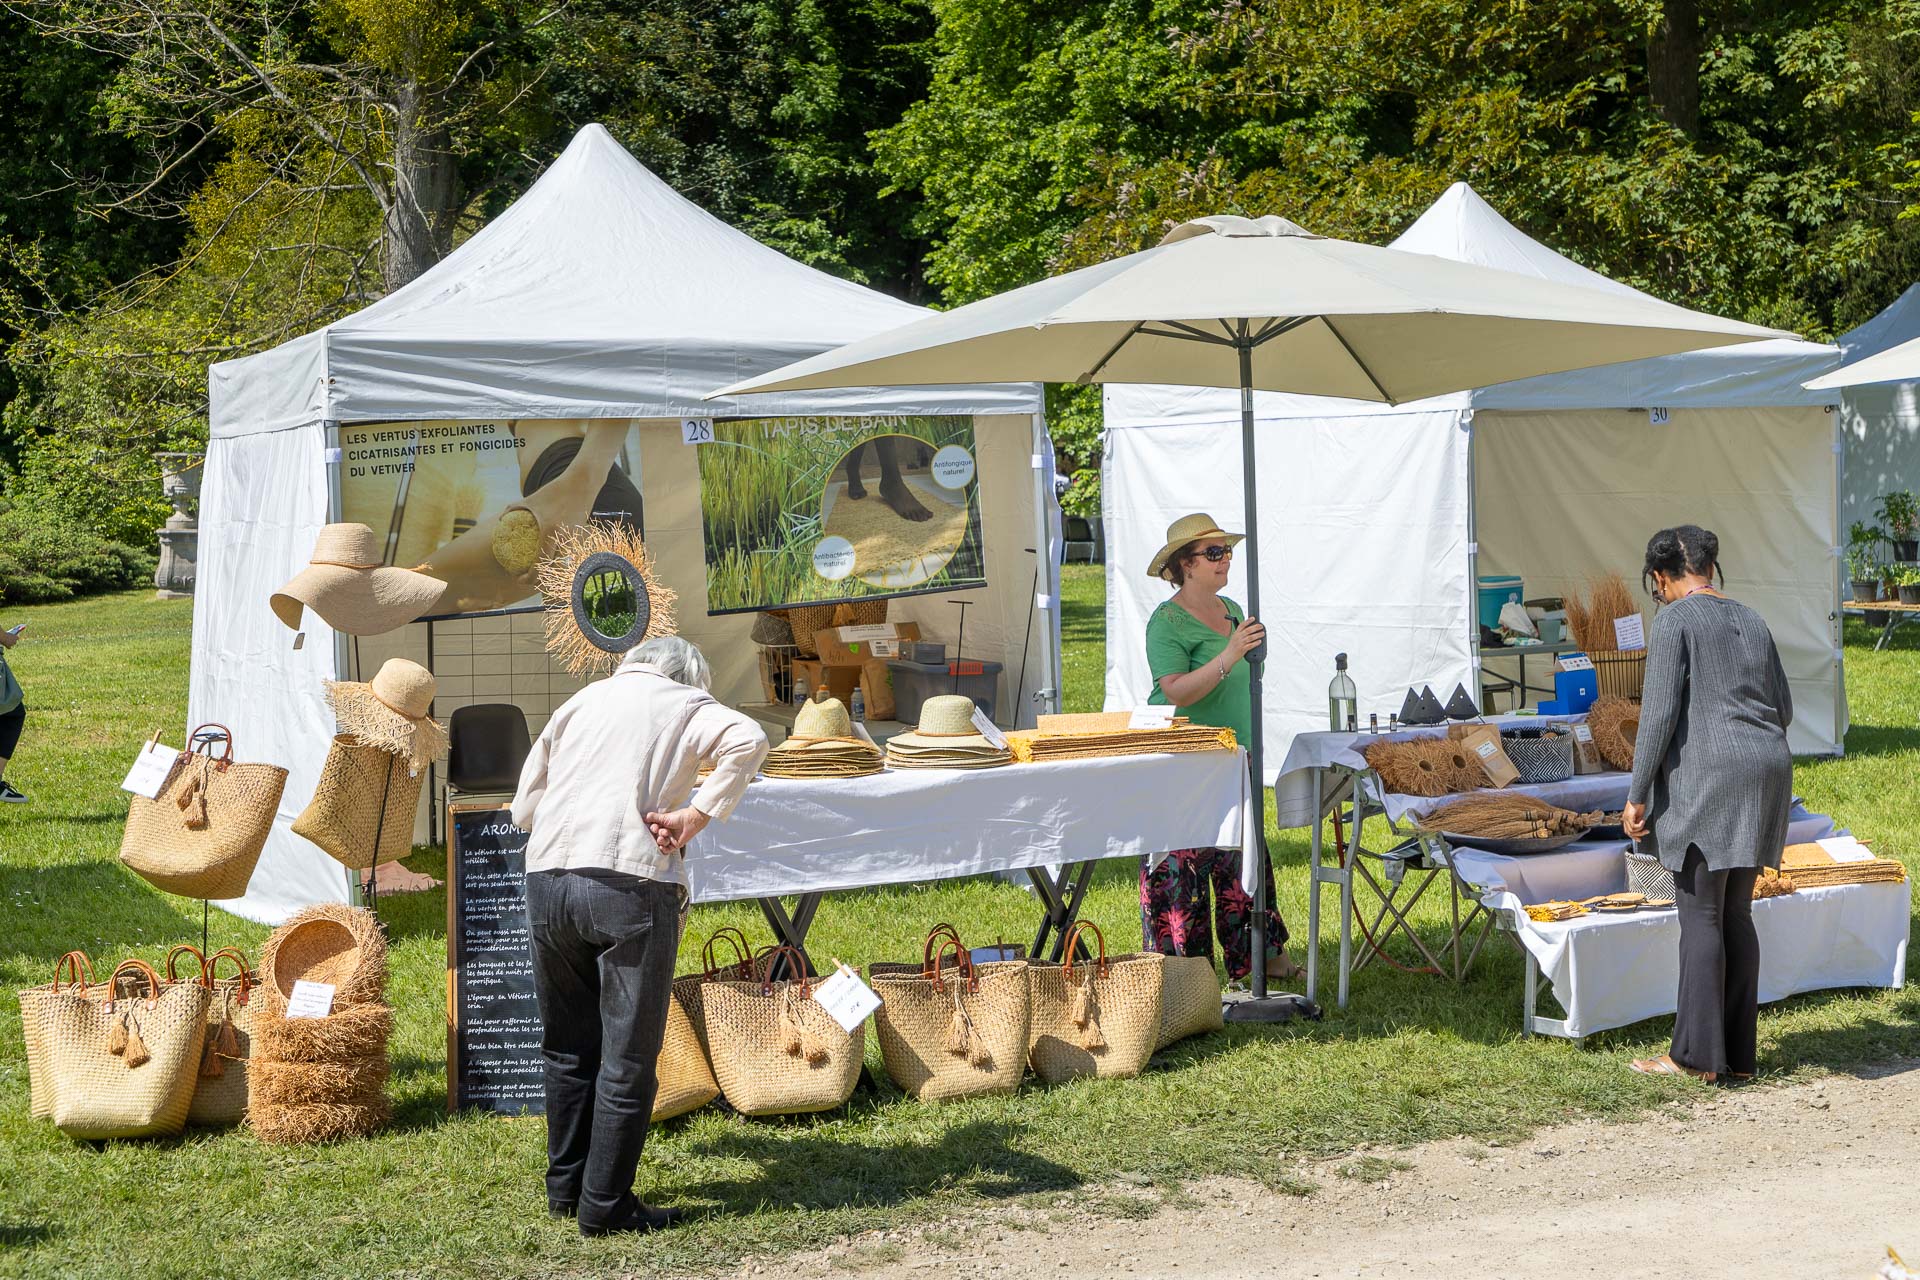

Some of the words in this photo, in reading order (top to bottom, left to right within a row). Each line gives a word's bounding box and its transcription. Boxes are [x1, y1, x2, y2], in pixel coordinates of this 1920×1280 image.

[1653, 407, 1668, 422] 30
[687, 419, 710, 441] 28
[760, 417, 819, 438] TAPIS
[825, 416, 854, 432] DE
[860, 415, 907, 429] BAIN
[347, 434, 367, 444] LES
[372, 430, 416, 442] VERTUS
[421, 424, 495, 439] EXFOLIANTES
[348, 445, 436, 461] CICATRISANTES
[441, 443, 454, 453] ET
[460, 438, 526, 452] FONGICIDES
[350, 467, 365, 477] DU
[371, 463, 415, 475] VETIVER
[942, 468, 965, 476] naturel
[823, 560, 846, 568] naturel
[490, 880, 521, 888] seulement
[497, 896, 519, 904] permet
[478, 961, 506, 969] bouquets
[476, 969, 494, 977] tables
[466, 978, 504, 986] soporifique.
[467, 993, 494, 1002] L'éponge
[507, 992, 532, 1000] Vétiver
[532, 991, 537, 999] à
[467, 1018, 483, 1026] Idéal
[502, 1017, 532, 1026] raffermir
[467, 1026, 504, 1035] profondeur
[468, 1042, 486, 1050] Boule
[487, 1042, 502, 1050] bien
[503, 1042, 517, 1050] être
[474, 1059, 501, 1067] disposer
[502, 1058, 518, 1066] dans
[468, 1068, 492, 1076] parfum
[510, 1066, 538, 1075] capacité
[539, 1065, 544, 1073] à
[502, 1083, 518, 1091] peut
[502, 1091, 513, 1099] qui
